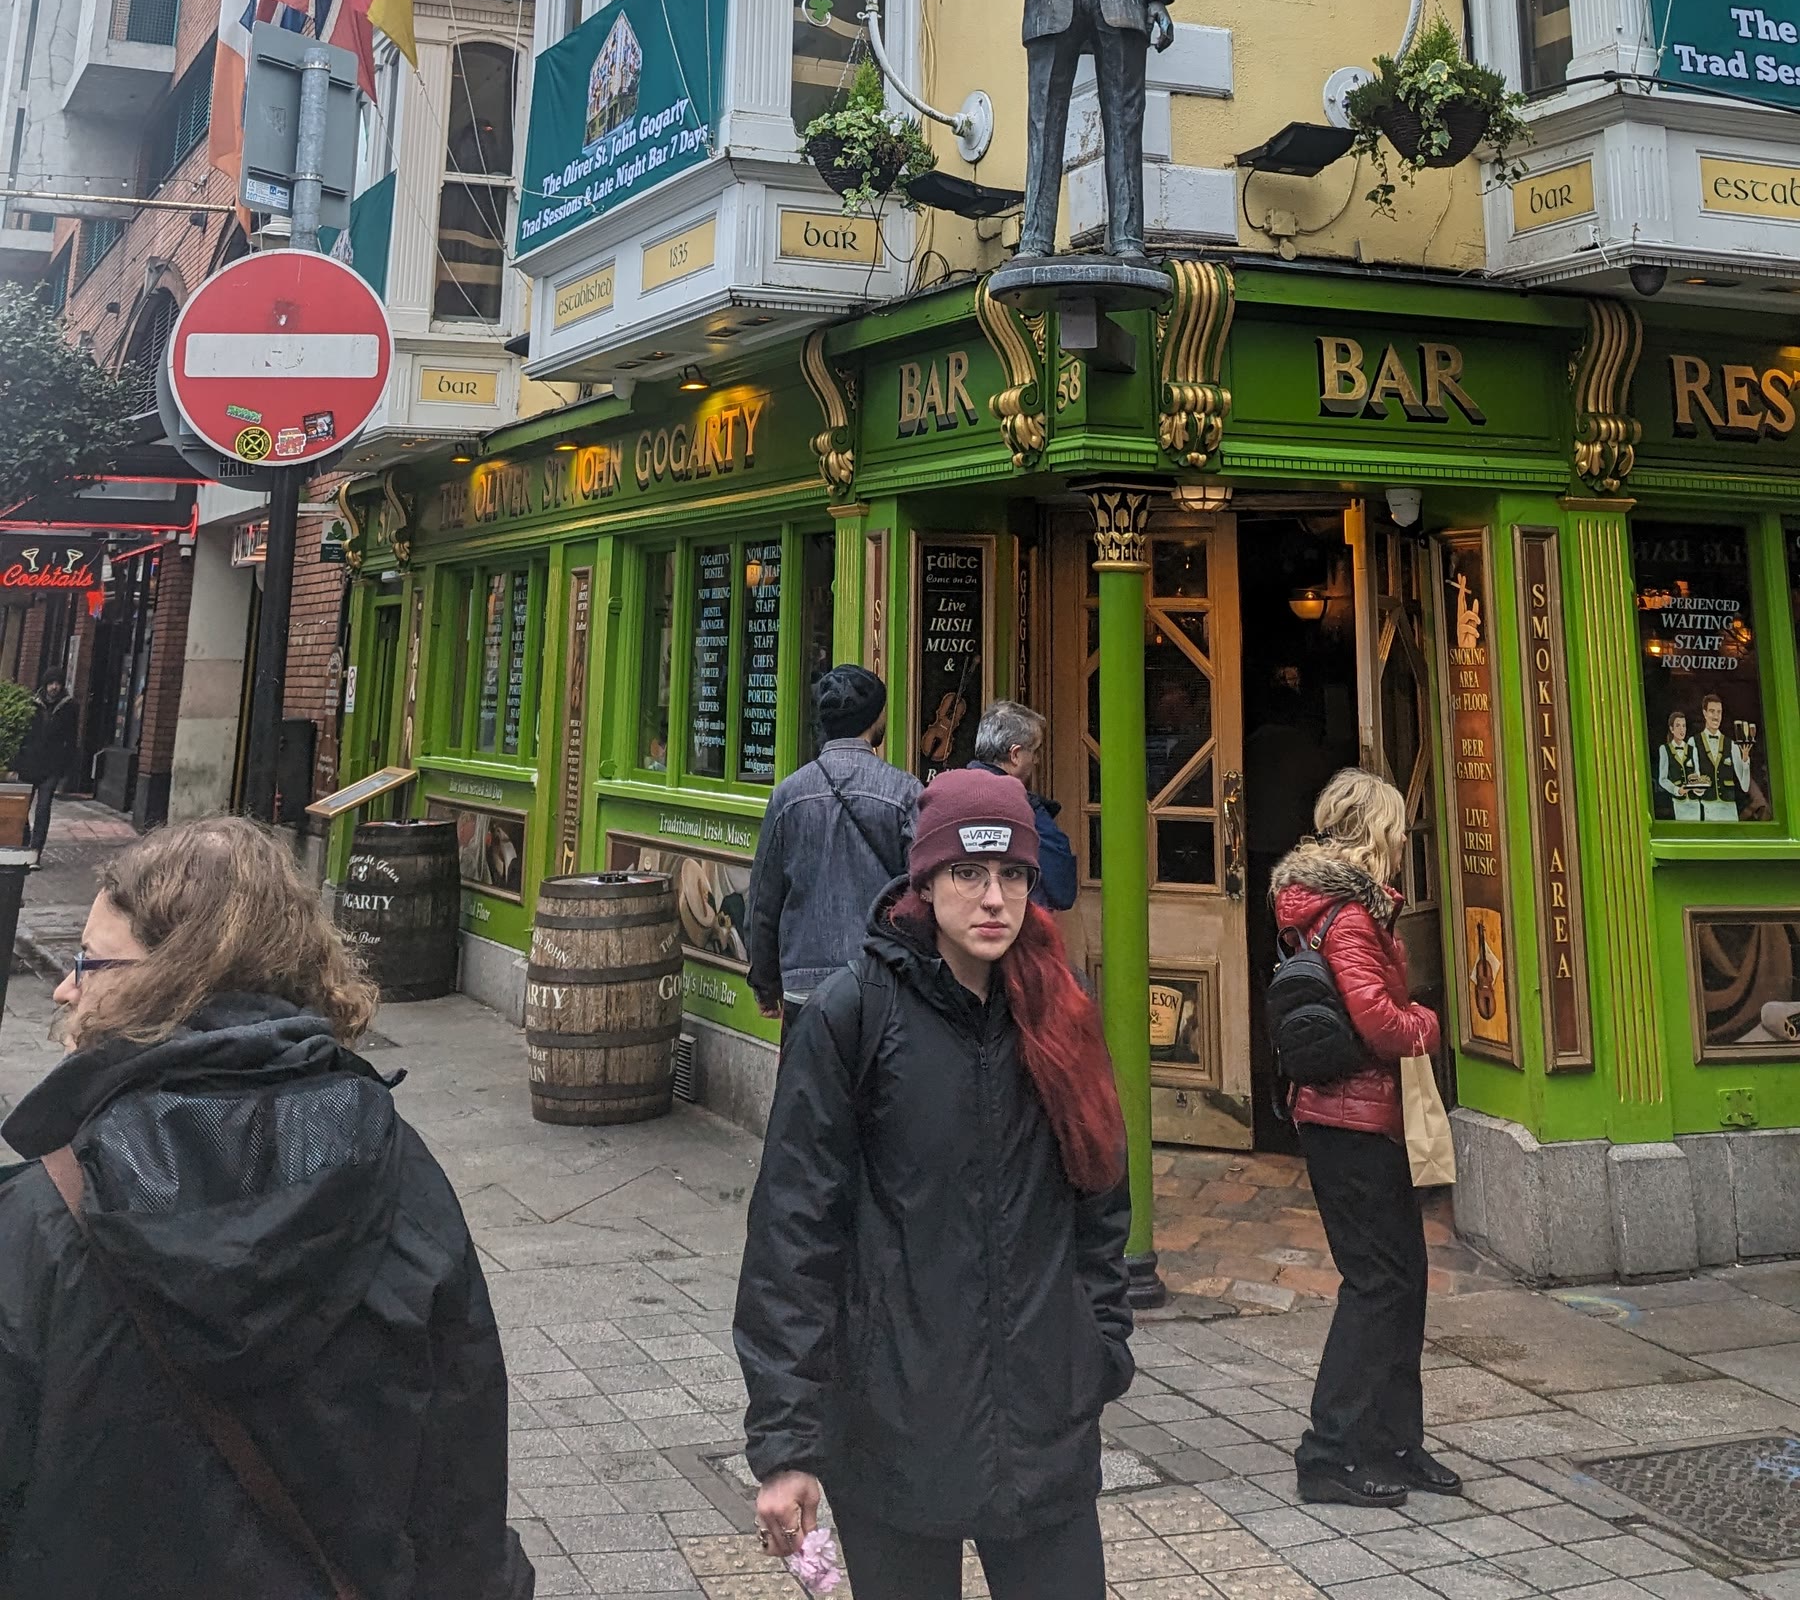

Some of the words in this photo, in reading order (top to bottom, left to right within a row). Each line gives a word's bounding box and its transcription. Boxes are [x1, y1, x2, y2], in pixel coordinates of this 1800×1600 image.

[1730, 6, 1798, 45] The
[1673, 43, 1750, 81] Trad
[543, 171, 562, 199] The
[563, 157, 593, 188] Oliver
[608, 128, 637, 166] John
[639, 98, 690, 142] Gogarty
[521, 214, 542, 240] Trad
[542, 196, 583, 229] Sessions
[592, 176, 614, 202] Late
[615, 160, 647, 193] Night
[647, 146, 669, 169] Bar
[669, 135, 678, 159] 7
[678, 123, 710, 155] Days
[1529, 182, 1574, 215] bar
[803, 220, 861, 252] bar
[668, 241, 689, 269] 1835
[558, 277, 613, 317] established
[437, 376, 478, 396] bar
[1318, 335, 1487, 425] BAR
[898, 351, 979, 438] BAR
[474, 466, 533, 522] OLIVER
[571, 440, 624, 502] JOHN
[635, 400, 766, 491] GOGARTY
[747, 547, 762, 560] NOW
[3, 563, 95, 588] Cocktails
[704, 566, 725, 580] HOSTEL
[926, 573, 950, 584] Come
[952, 575, 963, 584] on
[698, 588, 711, 600] NOW
[711, 586, 731, 600] HIRING
[755, 599, 777, 613] STAFF
[937, 598, 967, 612] Live
[1658, 596, 1740, 612] PERIENCED
[748, 619, 767, 633] BACK
[929, 617, 973, 632] IRISH
[1661, 612, 1735, 630] WAITING
[753, 634, 775, 649] STAFF
[925, 638, 976, 653] MUSIC
[1673, 634, 1725, 651] STAFF
[752, 654, 775, 668] CHEFS
[944, 657, 956, 672] &
[1450, 647, 1485, 666] SMOKING
[1661, 654, 1739, 672] REQUIRED
[700, 667, 720, 678] PORTER
[748, 673, 778, 688] KITCHEN
[1459, 670, 1480, 689] AREA
[747, 689, 778, 704] PORTERS
[1463, 692, 1489, 711] FLOOR
[698, 701, 720, 713] KEEPERS
[751, 721, 772, 736] STAFF
[1461, 738, 1485, 759] BEER
[1456, 760, 1493, 782] GARDEN
[1531, 583, 1560, 805] SMOKING
[1548, 847, 1572, 979] AREA
[1464, 807, 1490, 829] LIVE
[660, 813, 702, 838] Traditional
[703, 819, 723, 841] Irish
[725, 824, 752, 848] Music
[969, 829, 1003, 840] VANS
[1465, 831, 1494, 854] IRISH
[375, 859, 401, 884] John
[1463, 854, 1497, 877] MUSIC
[476, 902, 491, 922] Floor
[358, 931, 382, 945] Bar
[543, 937, 570, 965] JOHN
[699, 974, 720, 1002] Irish
[719, 980, 738, 1006] Bar
[532, 1046, 549, 1062] Bar
